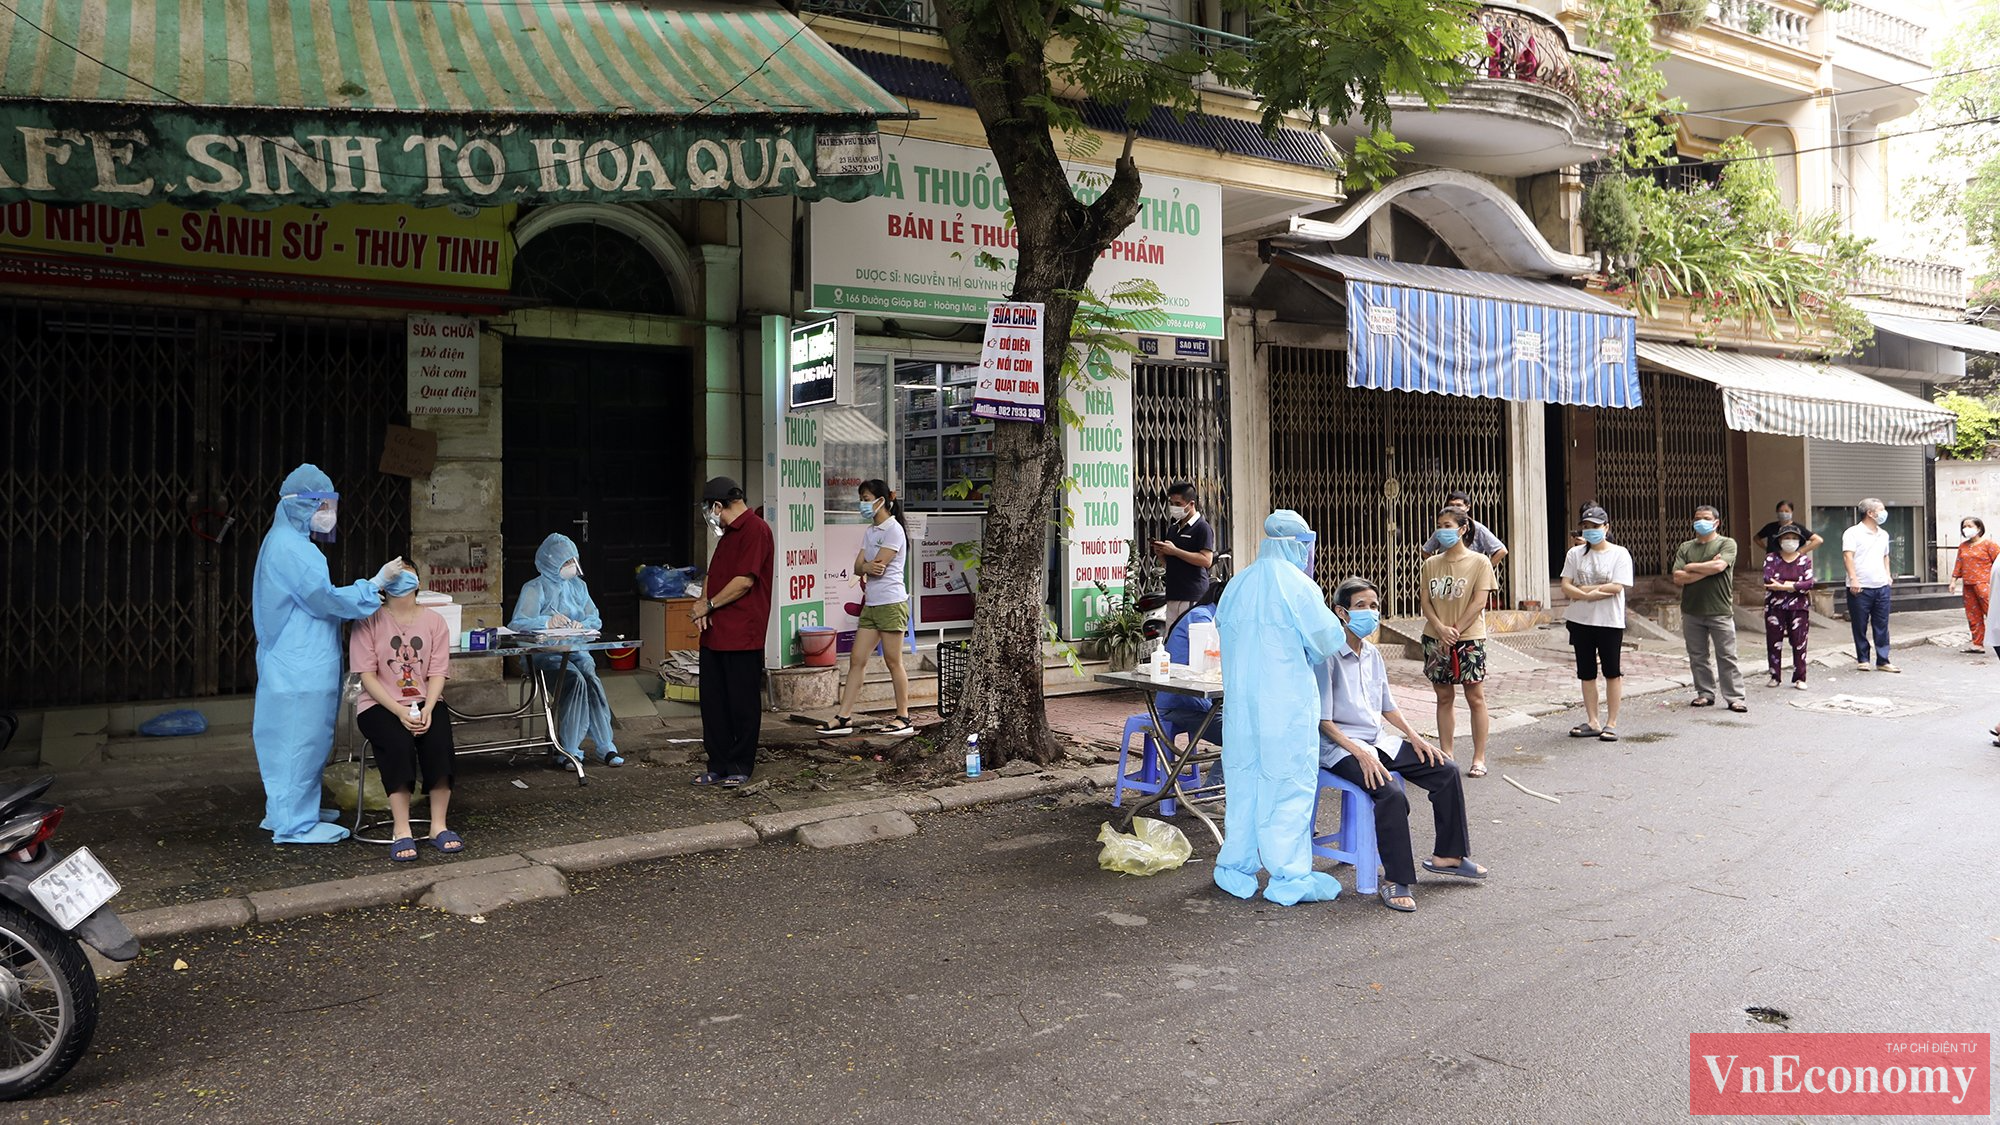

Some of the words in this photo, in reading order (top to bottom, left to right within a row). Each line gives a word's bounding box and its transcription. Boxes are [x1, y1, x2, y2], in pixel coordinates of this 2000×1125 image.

[186, 134, 387, 194] SINH
[530, 139, 676, 190] HOA
[1137, 187, 1201, 236] THẢO
[181, 208, 271, 257] SÀNH
[282, 213, 328, 261] SỨ
[355, 216, 428, 269] THỦY
[437, 236, 499, 275] TINH
[888, 212, 933, 241] BÁN
[941, 213, 964, 243] LẺ
[1112, 236, 1164, 264] PHẨM
[856, 268, 887, 283] DƯỢC
[904, 271, 945, 287] NGUYỄN
[964, 276, 998, 291] QUỲNH
[845, 293, 860, 302] 166
[862, 295, 889, 307] Đường
[934, 301, 960, 312] Hoàng
[962, 302, 976, 312] Mai
[413, 319, 436, 337] SỬA
[442, 321, 474, 338] CHỮA
[440, 347, 464, 361] điện
[1142, 340, 1157, 352] 166
[1179, 341, 1191, 350] SAO
[1193, 341, 1206, 352] VIỆT
[443, 369, 467, 379] cơm
[421, 385, 448, 399] Quạt
[451, 386, 477, 400] điện
[995, 378, 1016, 395] QUẠT
[1085, 386, 1114, 415] NHÀ
[1078, 420, 1123, 452] THUỐC
[781, 457, 822, 488] PHƯƠNG
[1072, 461, 1129, 488] PHƯƠNG
[789, 492, 814, 532] THẢO
[1084, 491, 1119, 526] THẢO
[1081, 536, 1106, 555] THUỐC
[1109, 535, 1122, 554] TỐT
[786, 550, 797, 570] ĐẠT
[840, 569, 847, 579] 4
[1076, 567, 1092, 581] CHO
[790, 574, 815, 600] GPP
